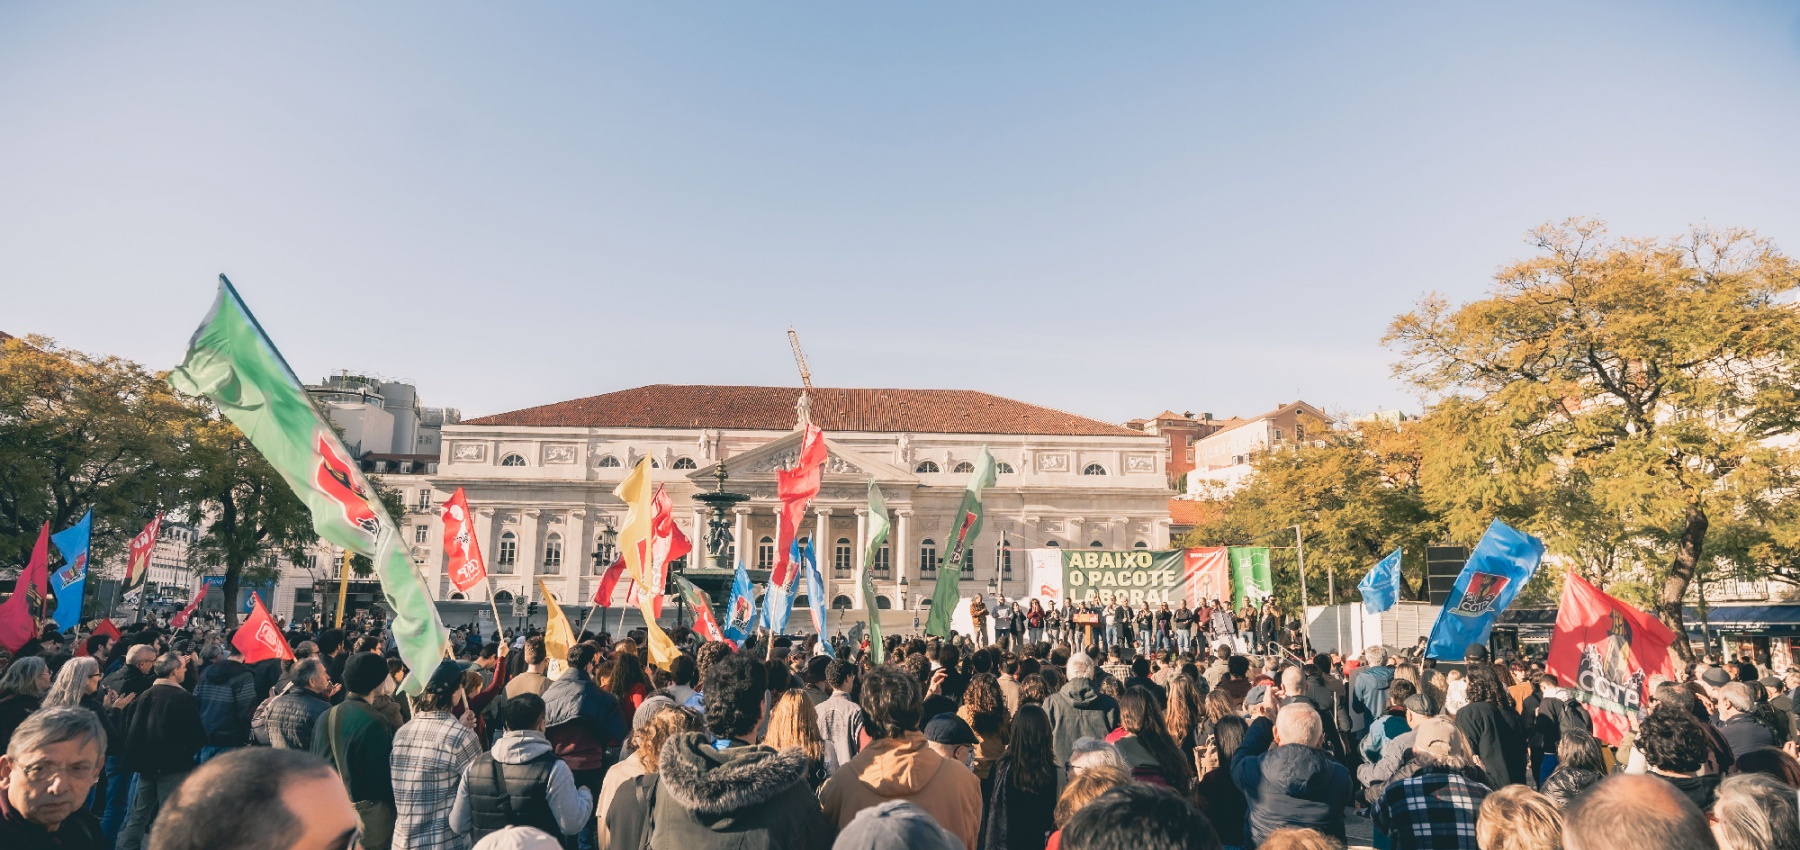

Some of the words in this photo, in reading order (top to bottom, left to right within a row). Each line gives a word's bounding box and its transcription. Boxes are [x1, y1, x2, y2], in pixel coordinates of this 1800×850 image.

[1069, 552, 1153, 568] ABAIXO
[1069, 570, 1084, 587] O
[1088, 570, 1176, 587] PACOTE
[1069, 588, 1175, 606] LABORAL
[1461, 600, 1489, 612] CGTP
